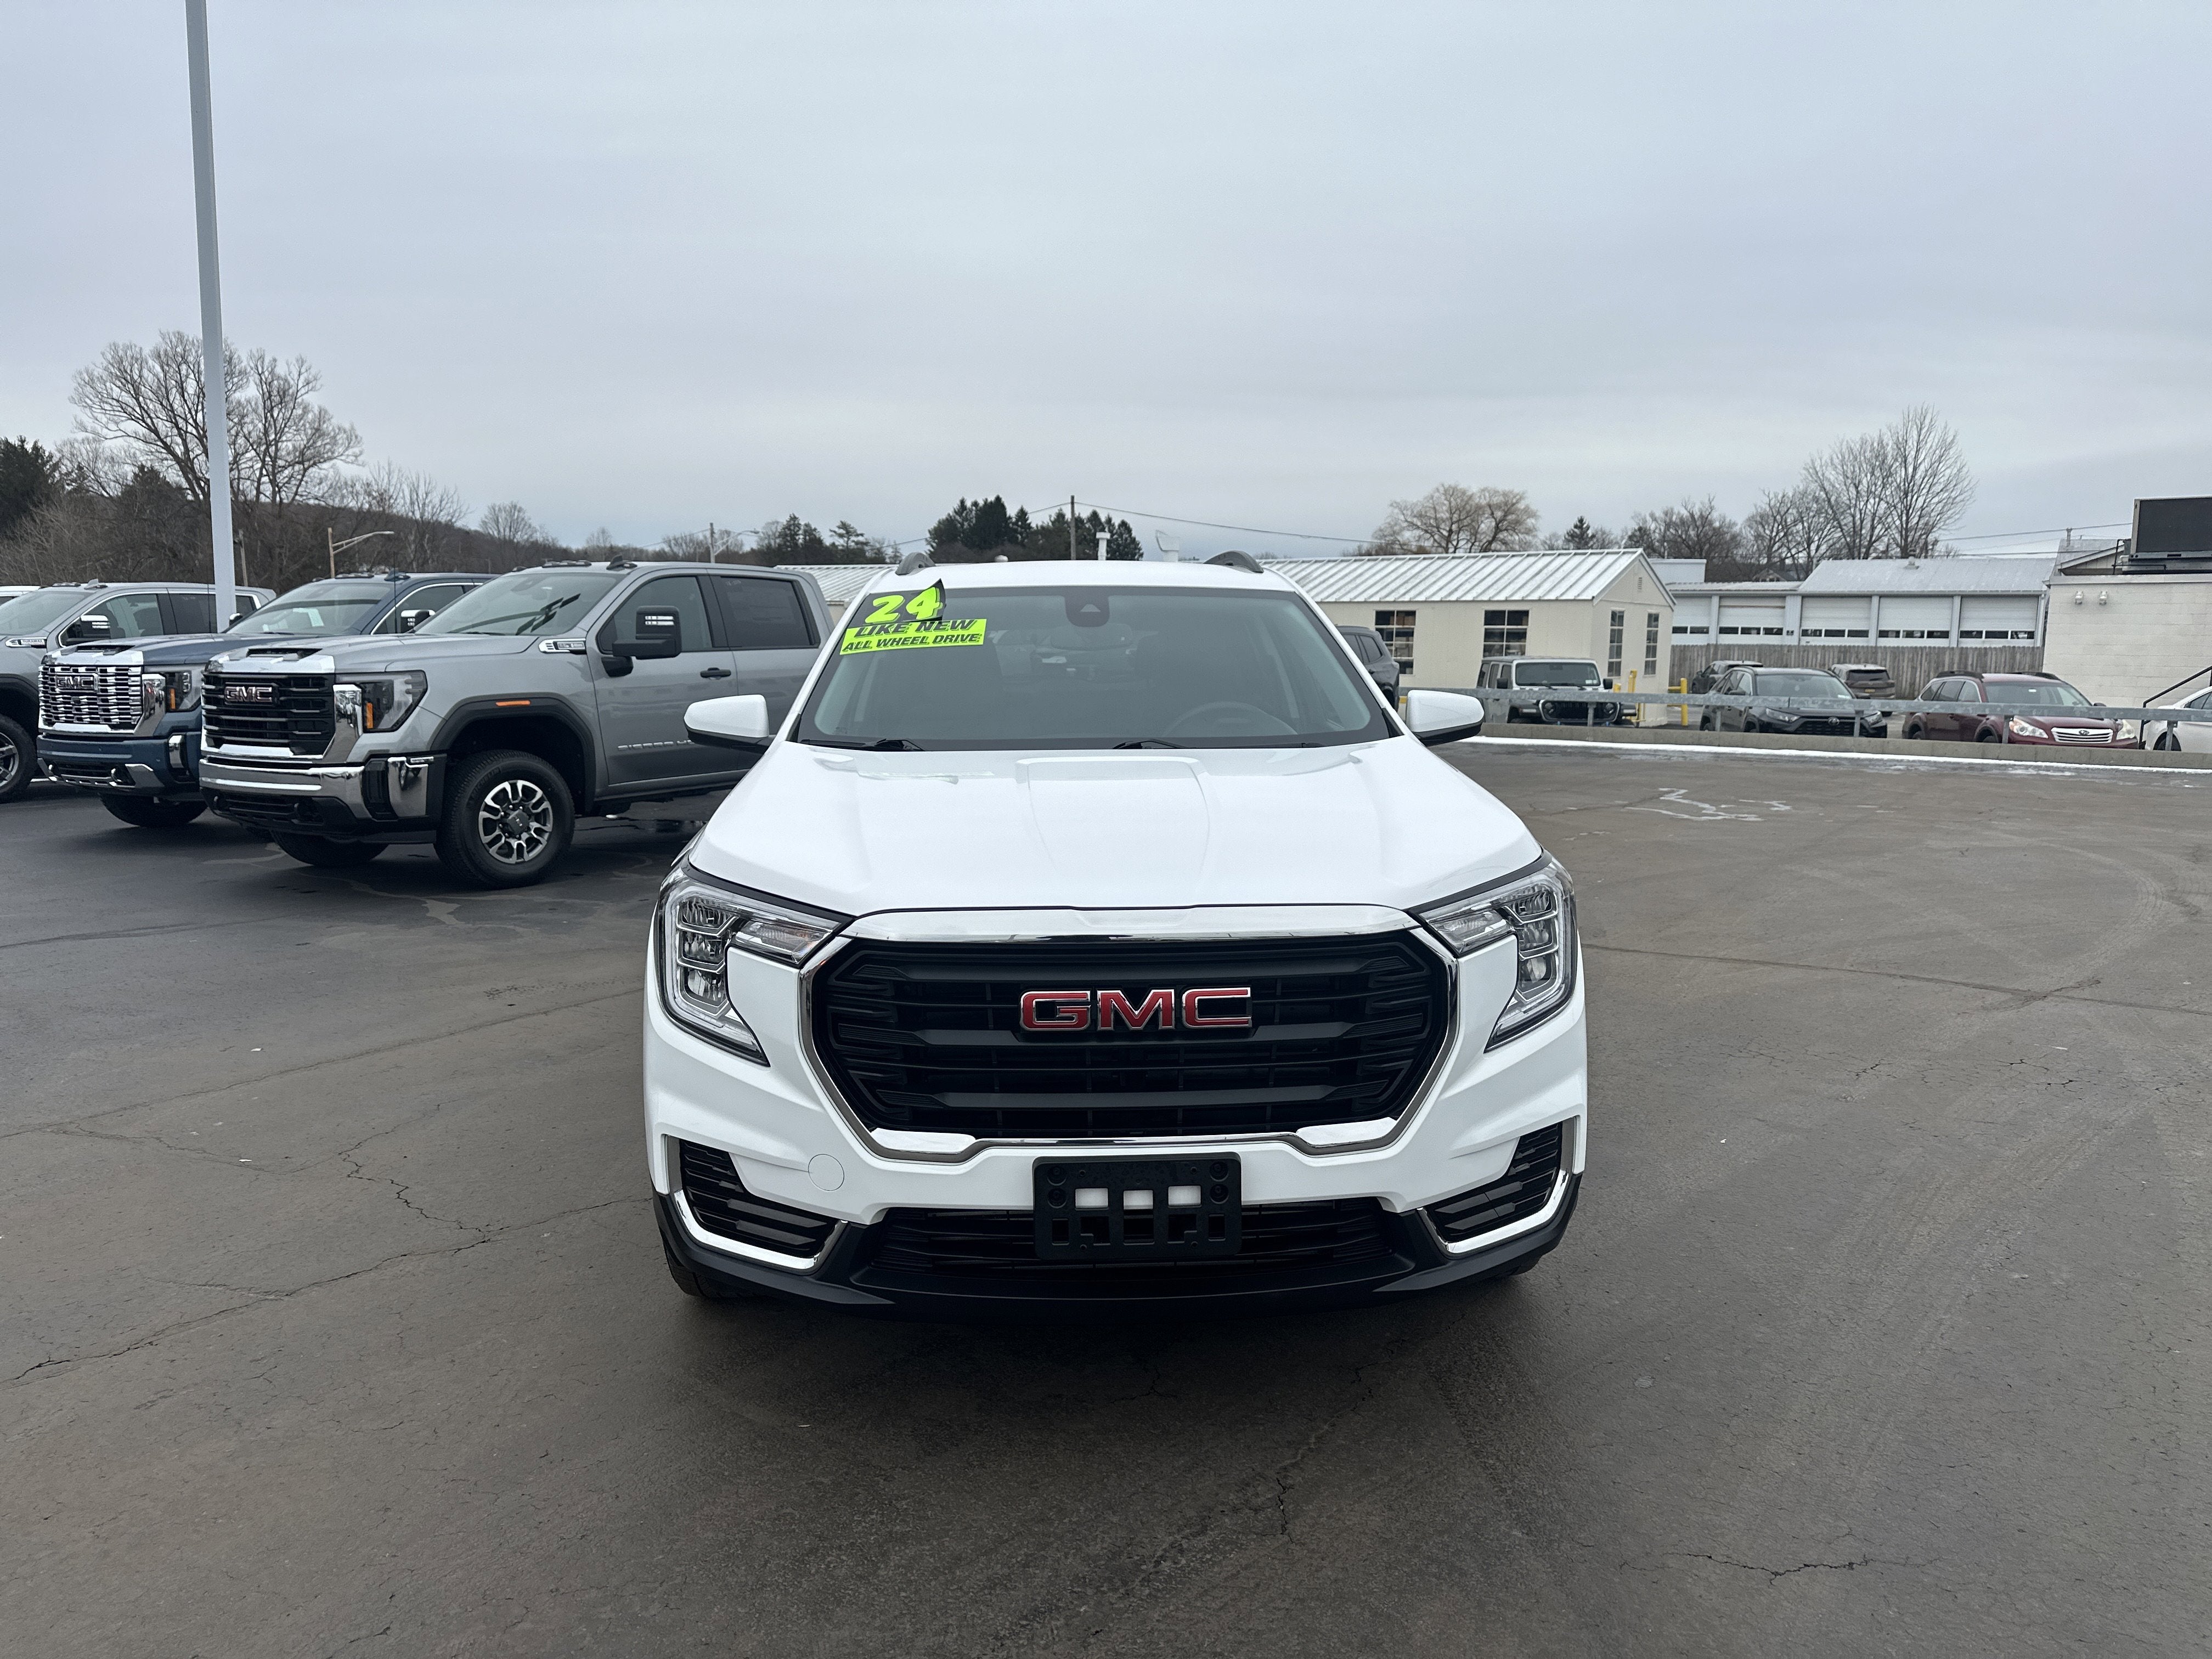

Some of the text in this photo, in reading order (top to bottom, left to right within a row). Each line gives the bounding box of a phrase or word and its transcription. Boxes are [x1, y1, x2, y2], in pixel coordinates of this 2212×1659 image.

[865, 586, 943, 623] 24
[854, 619, 978, 638] LIKE NEW
[842, 634, 982, 652] ALL WHEEL DRIVE
[224, 686, 273, 702] GMC
[1020, 987, 1252, 1030] GMC
